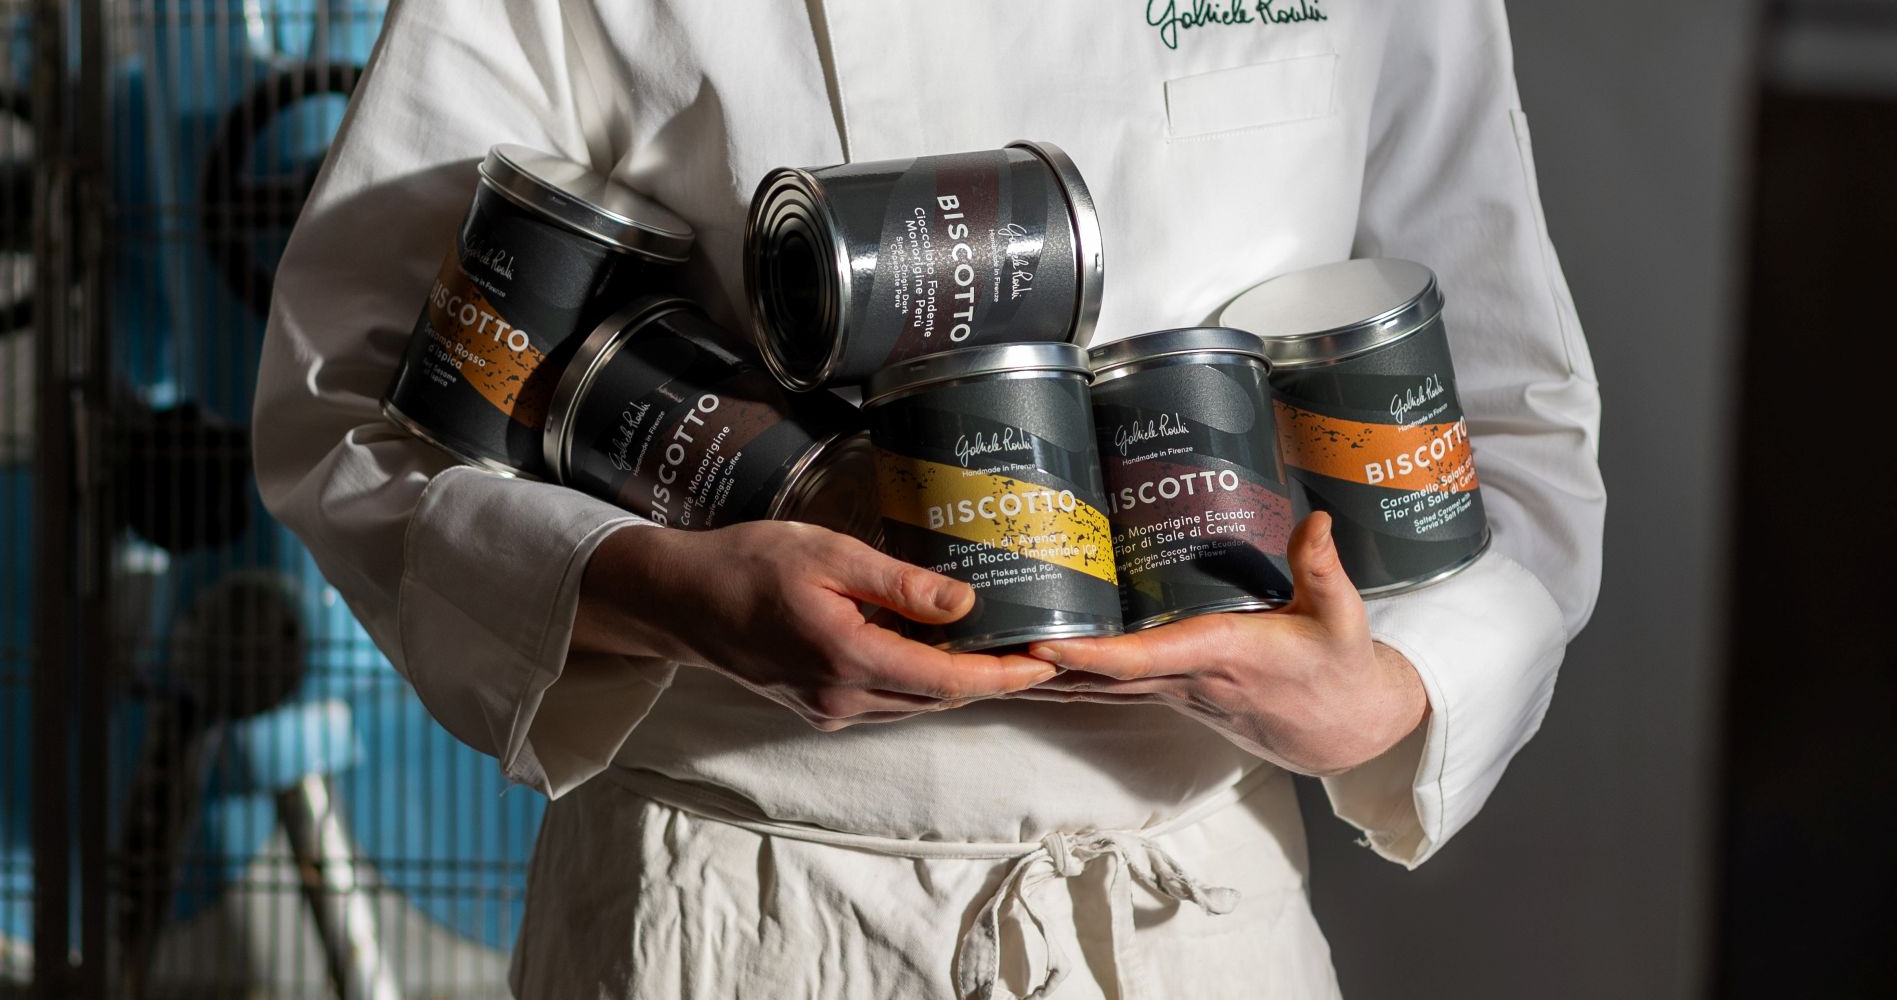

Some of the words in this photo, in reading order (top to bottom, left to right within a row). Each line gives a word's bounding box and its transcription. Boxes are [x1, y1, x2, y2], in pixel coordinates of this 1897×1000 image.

[914, 207, 935, 275] Cioccolato
[905, 220, 925, 295] Monorigine
[936, 194, 975, 342] BISCOTTO
[901, 293, 909, 315] Dark
[993, 276, 1001, 303] Firenze
[913, 299, 926, 327] Perù
[924, 280, 938, 337] Fondente
[454, 342, 486, 367] Rosso
[650, 410, 665, 434] Firenze
[1397, 416, 1428, 432] Handmade
[651, 393, 720, 528] BISCOTTO
[688, 426, 730, 494] Monorigine
[724, 451, 742, 476] Coffee
[1122, 451, 1159, 467] Handmade
[1167, 445, 1194, 455] Firenze
[1365, 415, 1468, 485] BISCOTTO
[694, 456, 725, 508] Tanzania
[962, 466, 1001, 478] Handmade
[1011, 463, 1036, 471] Firenze
[1110, 469, 1239, 514] ISCOTTO
[1380, 483, 1439, 509] Caramello
[1440, 465, 1466, 486] Salato
[927, 489, 1077, 530] BISCOTTO
[1384, 506, 1410, 522] Fior
[1413, 501, 1425, 512] di
[1427, 490, 1449, 507] Sale
[1451, 483, 1459, 495] di
[1413, 512, 1437, 527] Salted
[1437, 498, 1461, 517] Caramel
[1128, 515, 1201, 539] Monorigine
[1205, 508, 1256, 522] Ecuador
[1415, 519, 1444, 535] Cervia's
[1444, 510, 1457, 522] Salt
[948, 539, 996, 557] Fiocchi
[1001, 535, 1013, 548] di
[1018, 533, 1057, 545] Avena
[1114, 543, 1136, 557] Fior
[1140, 536, 1152, 549] di
[1156, 530, 1185, 544] Sale
[1189, 526, 1202, 538] di
[1206, 522, 1247, 535] Cervia
[962, 555, 974, 568] di
[978, 551, 1020, 566] Rocca
[1024, 546, 1080, 561] Imperiale
[1117, 561, 1133, 572] ingle
[1134, 553, 1159, 565] Origin
[1160, 547, 1188, 558] Cocoa
[1189, 543, 1209, 552] from
[1212, 539, 1245, 549] Ecuador
[1129, 566, 1143, 575] and
[1145, 557, 1177, 570] Cervia's
[1179, 553, 1196, 562] Salt
[1198, 549, 1227, 558] Flower
[972, 572, 989, 581] Oat
[990, 568, 1019, 579] Flakes
[1021, 566, 1036, 574] and
[1039, 564, 1053, 572] PGI
[993, 574, 1033, 587] Imperiale
[1035, 572, 1063, 581] Lemon
